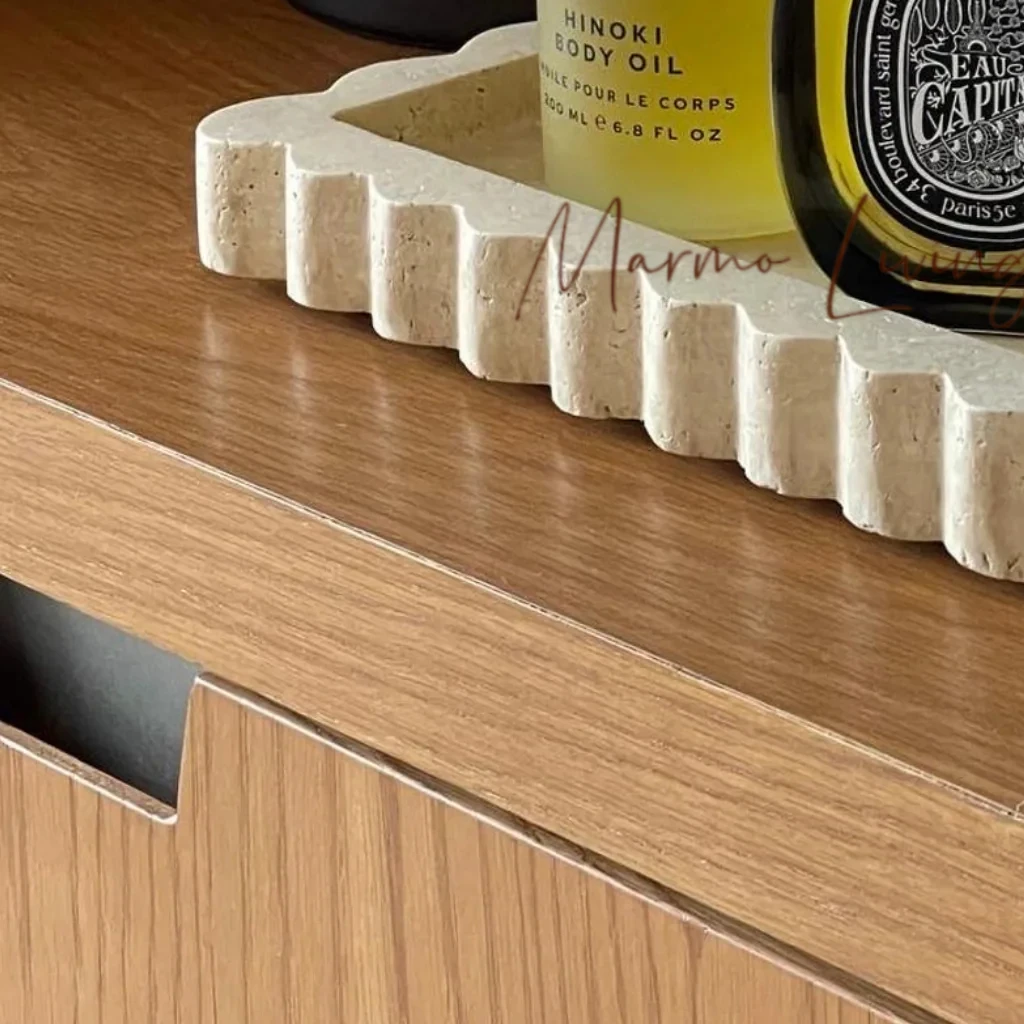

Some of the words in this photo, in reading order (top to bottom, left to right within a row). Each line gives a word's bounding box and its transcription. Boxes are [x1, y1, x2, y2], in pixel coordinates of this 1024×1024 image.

[564, 8, 662, 45] HINOKI
[555, 32, 614, 67] BODY
[628, 52, 684, 75] OIL
[873, 34, 892, 82] saint
[951, 54, 1007, 79] EAU
[574, 78, 616, 103] POUR
[626, 93, 649, 108] LE
[659, 96, 736, 111] CORPS
[544, 92, 564, 115] 200
[569, 108, 588, 126] ML
[613, 120, 643, 137] 6.8
[654, 126, 678, 140] FL
[690, 128, 722, 142] OZ
[873, 86, 909, 184] boulevard
[905, 177, 937, 203] 34
